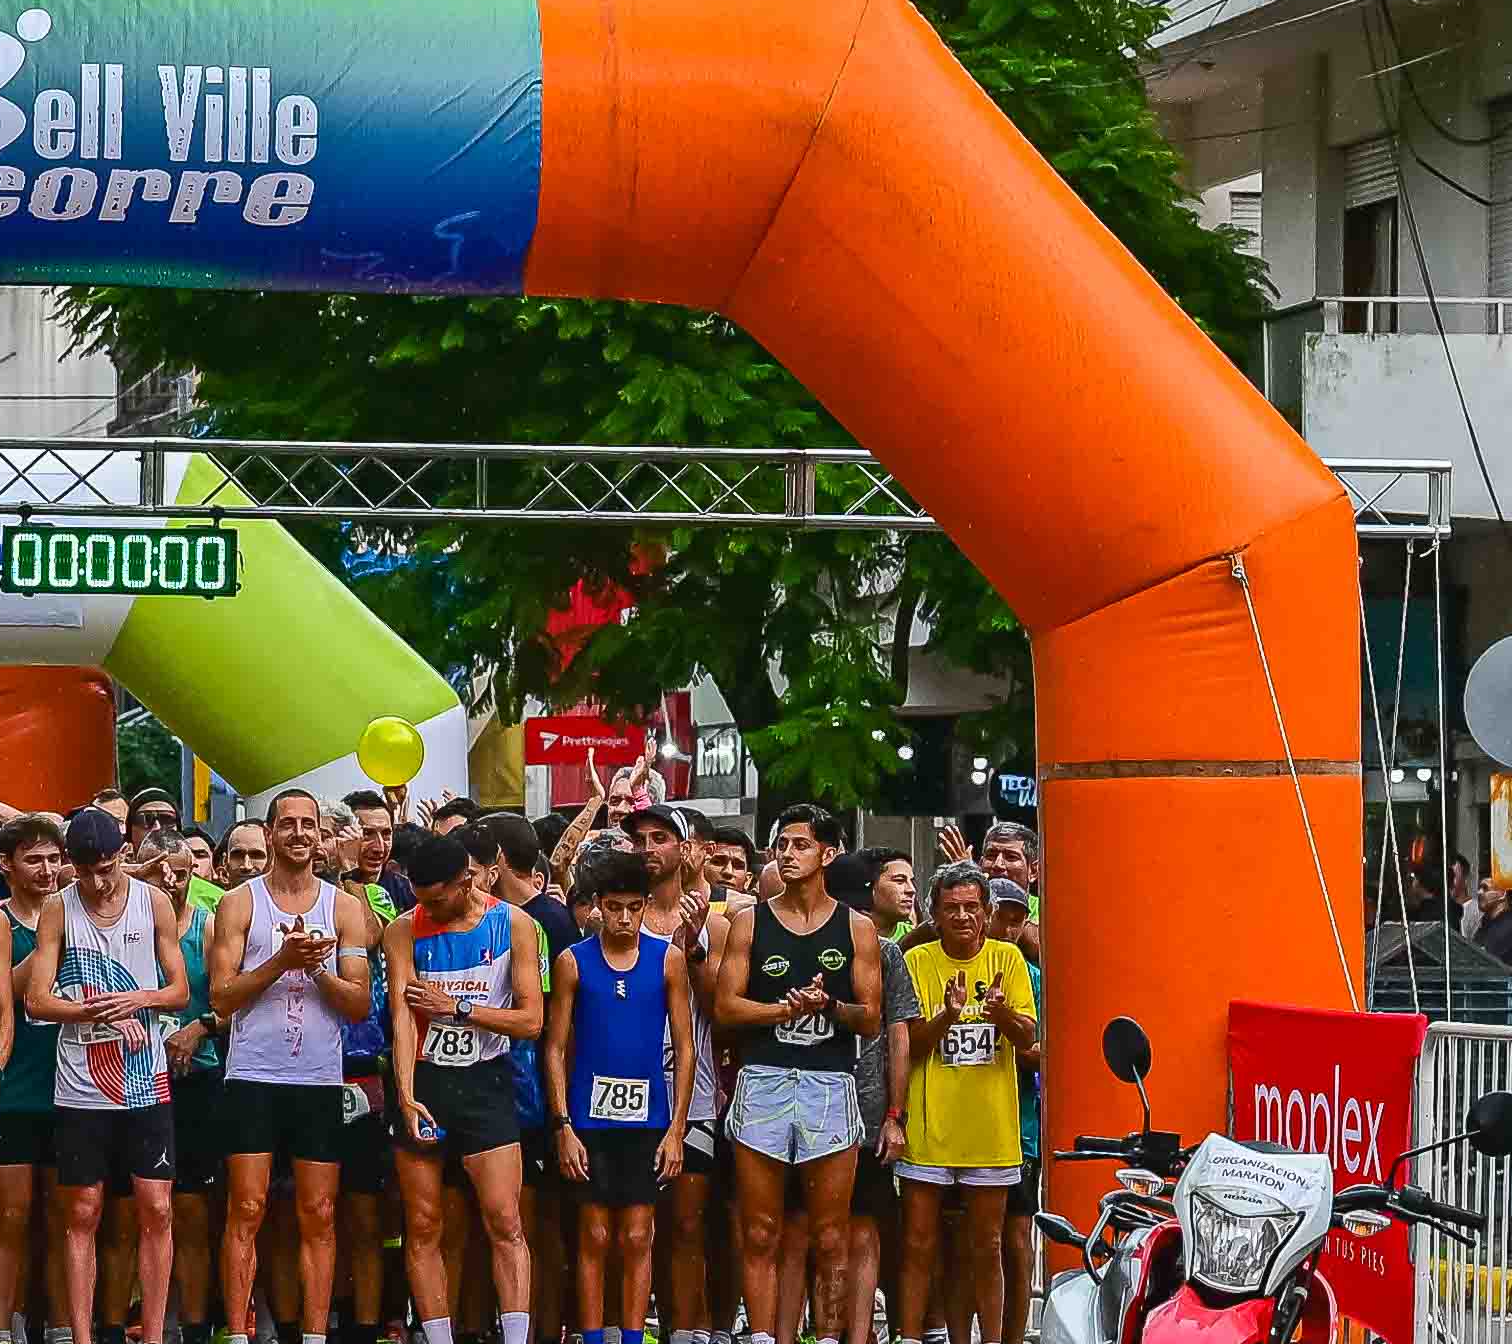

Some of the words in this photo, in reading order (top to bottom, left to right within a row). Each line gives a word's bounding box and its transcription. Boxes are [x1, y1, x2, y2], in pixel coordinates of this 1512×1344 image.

[157, 64, 318, 166] Ville
[10, 532, 228, 590] 00:00:00
[429, 1026, 474, 1056] 783
[943, 1027, 993, 1056] 654
[596, 1080, 644, 1111] 785
[1222, 1168, 1285, 1191] MARATON
[1223, 1193, 1263, 1205] HONDA
[1336, 1237, 1354, 1262] TUS
[1361, 1246, 1385, 1276] PIES
